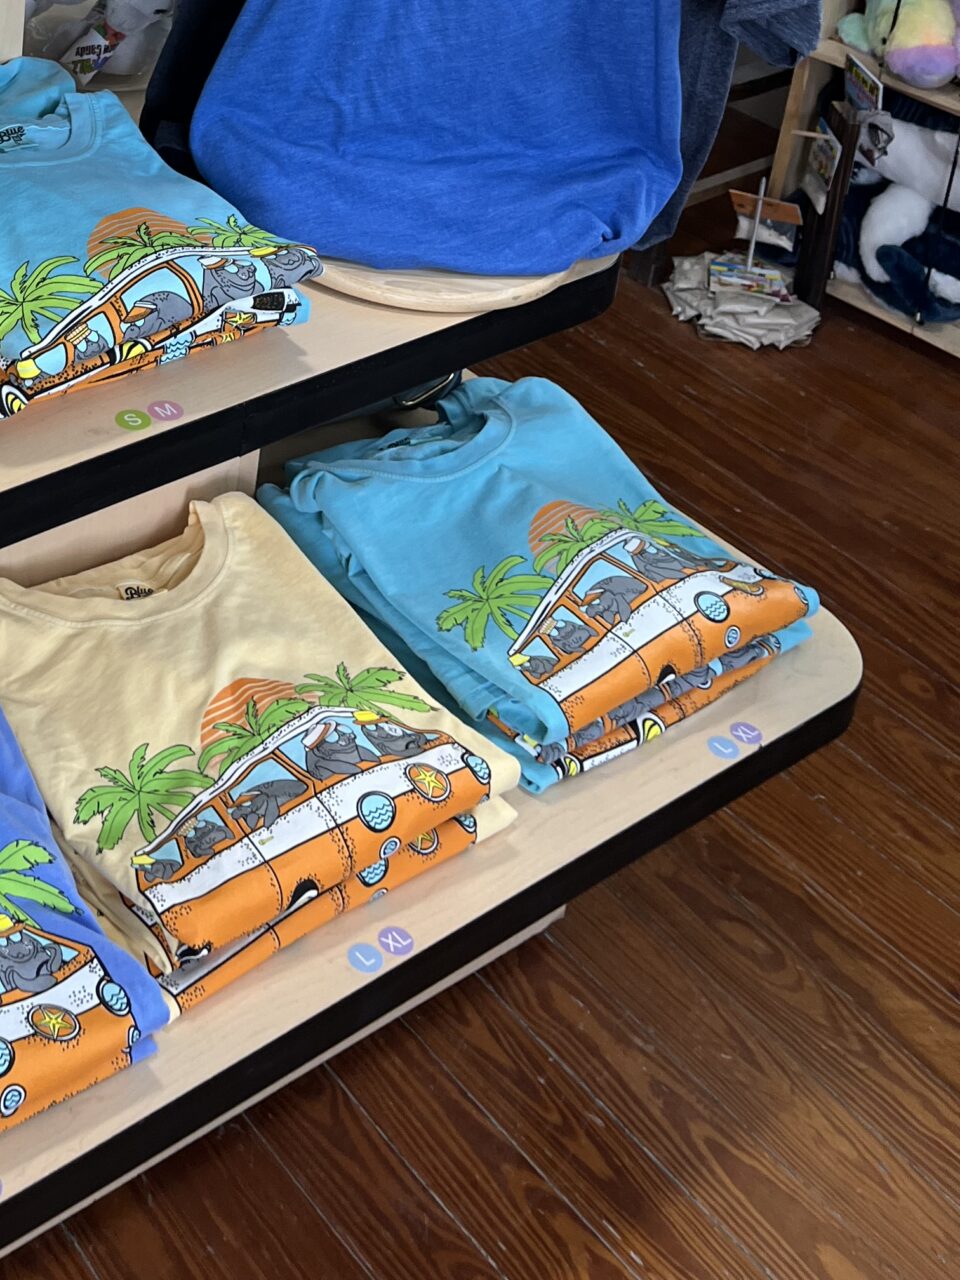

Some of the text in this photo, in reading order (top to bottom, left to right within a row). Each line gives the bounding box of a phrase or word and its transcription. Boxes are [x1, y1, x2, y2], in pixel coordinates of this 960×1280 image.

[123, 403, 178, 426] S M
[712, 725, 759, 754] L XL
[354, 930, 412, 966] L XL
